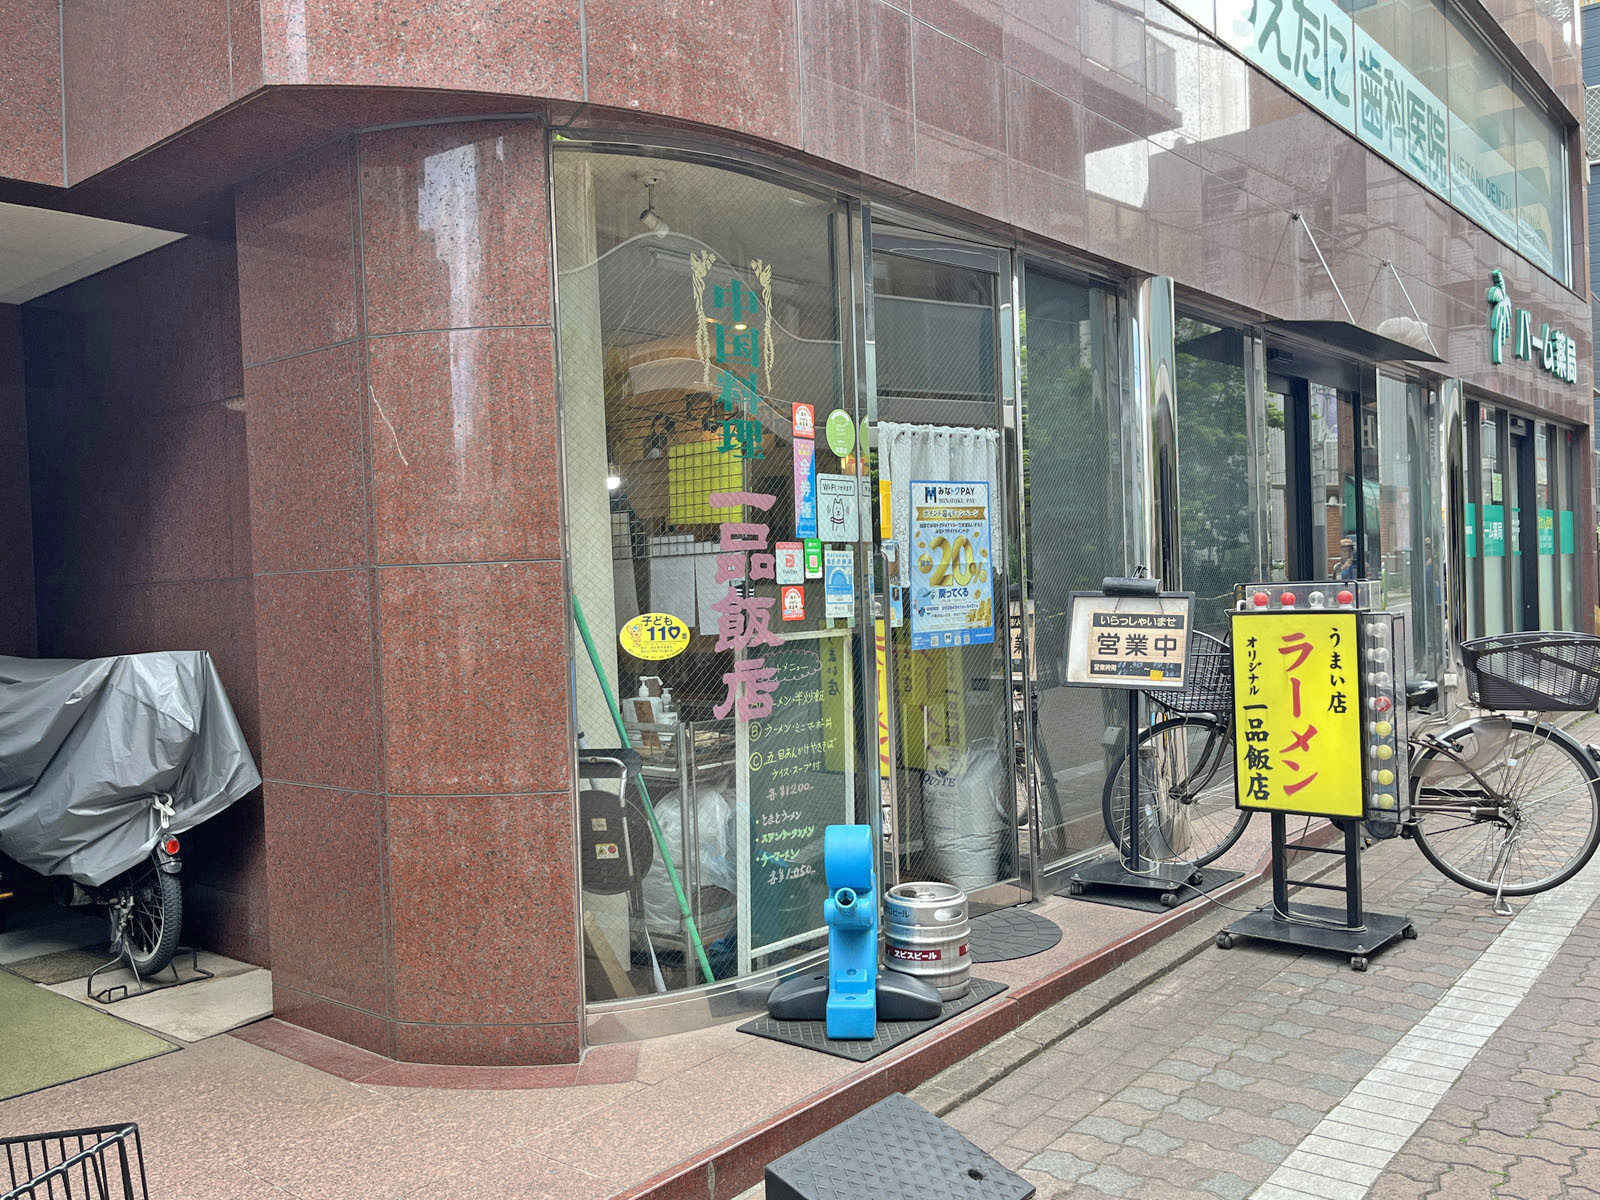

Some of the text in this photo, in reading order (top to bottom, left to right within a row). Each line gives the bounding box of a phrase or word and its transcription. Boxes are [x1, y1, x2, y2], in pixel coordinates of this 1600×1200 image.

[713, 278, 766, 460] 中国料理
[938, 486, 975, 496] みなトクPAY
[929, 536, 987, 587] 20%
[709, 491, 785, 722] 一品飯店
[938, 587, 969, 599] 戻ってくる
[641, 615, 673, 627] 子ども
[1097, 632, 1177, 657] 営業中
[1100, 615, 1176, 627] いらっしゃいませ
[1328, 627, 1348, 714] うまい店
[1243, 636, 1274, 801] オリジナル 一品飯店
[1278, 632, 1319, 796] ラーメン
